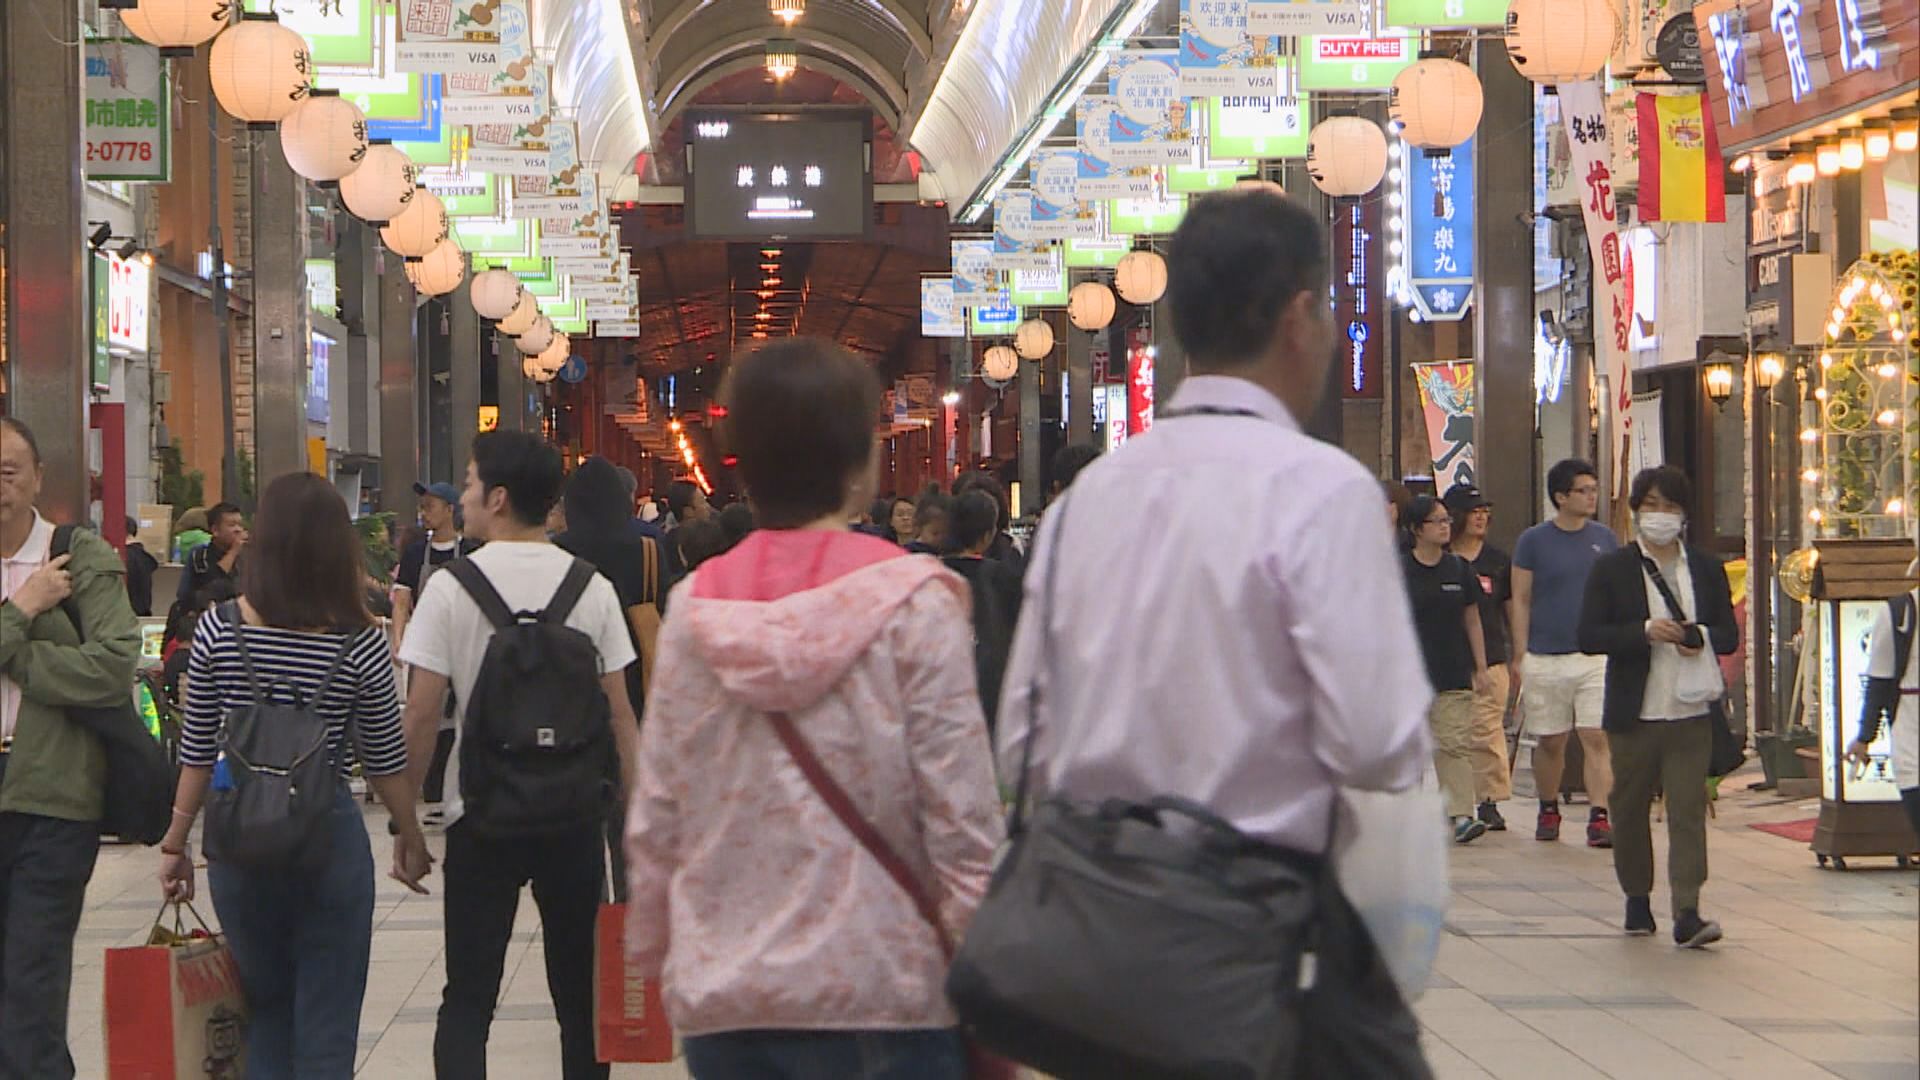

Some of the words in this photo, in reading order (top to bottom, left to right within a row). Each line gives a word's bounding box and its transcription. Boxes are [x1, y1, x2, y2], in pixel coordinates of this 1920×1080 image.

[1200, 1, 1247, 13] 欢迎来
[1326, 13, 1355, 24] VISA
[1320, 42, 1359, 54] DUTY
[1363, 42, 1399, 54] FREE
[468, 53, 496, 63] VISA
[1248, 77, 1274, 87] VISA
[506, 104, 531, 114] VISA
[1573, 114, 1606, 144] 名物
[1167, 148, 1189, 158] VISA
[524, 159, 546, 167] VISA
[1129, 184, 1150, 193] VISA
[559, 203, 579, 211] VISA
